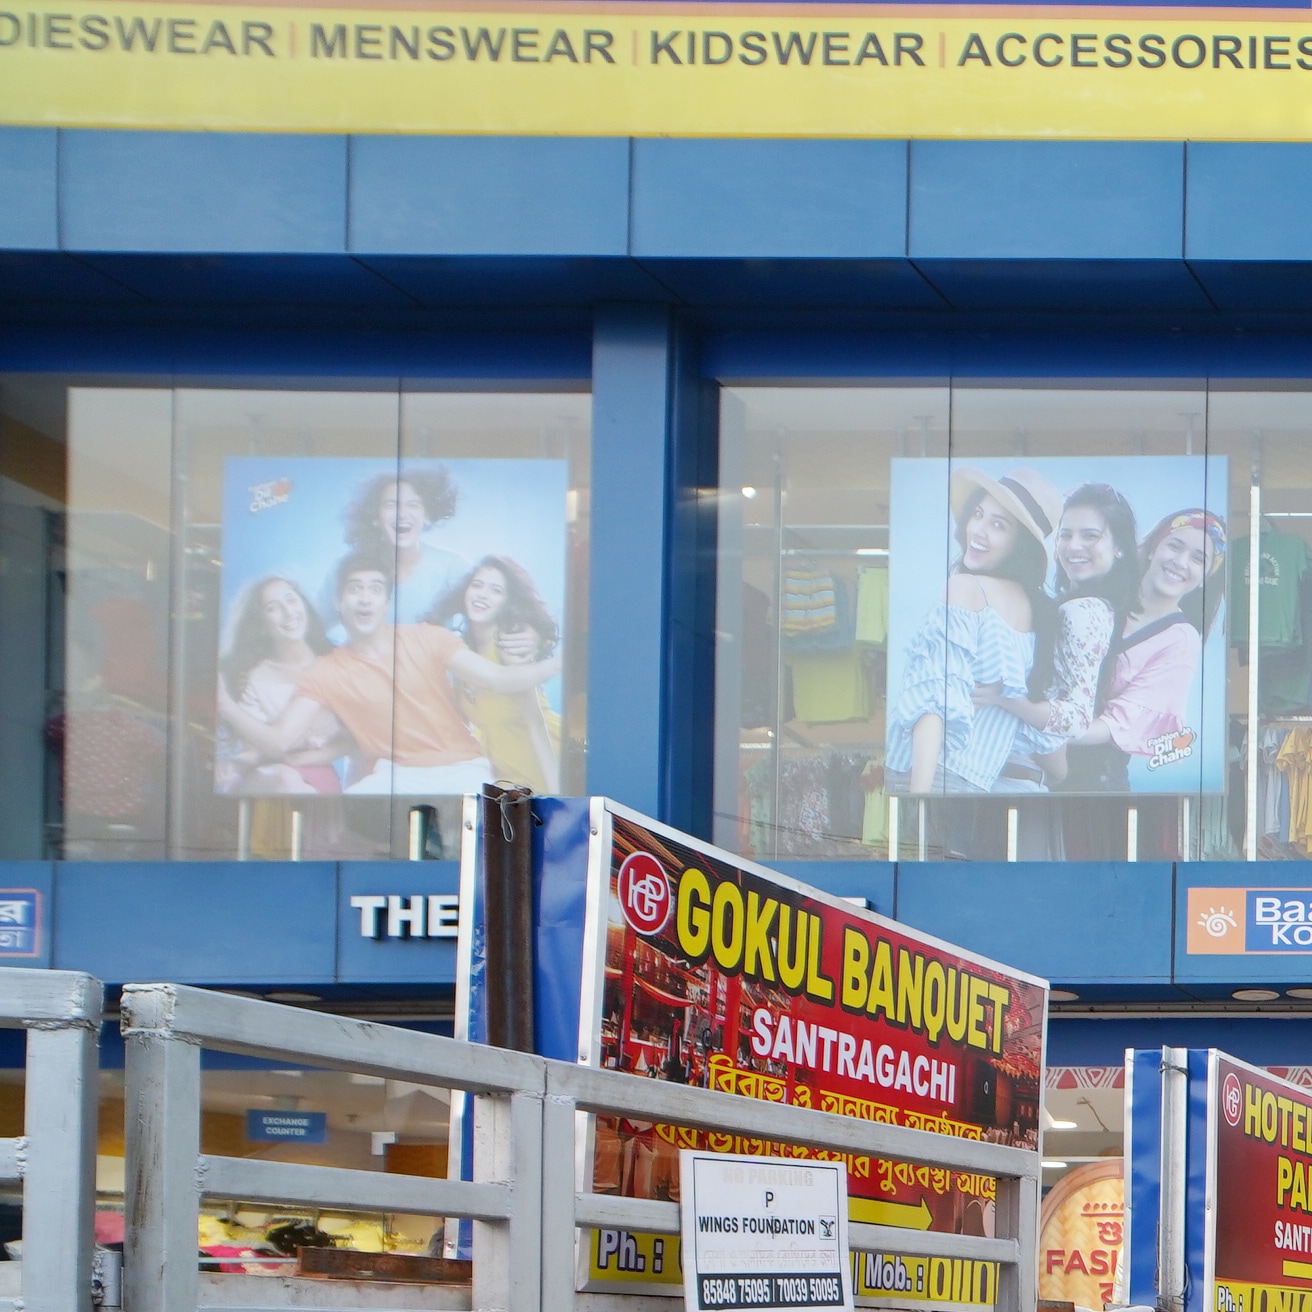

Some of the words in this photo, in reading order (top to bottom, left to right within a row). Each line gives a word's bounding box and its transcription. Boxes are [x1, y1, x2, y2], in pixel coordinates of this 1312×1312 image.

[308, 23, 616, 66] MENSWEAR
[648, 29, 926, 68] KIDSWEAR
[1149, 746, 1193, 769] Chahe
[1154, 739, 1173, 756] Dil
[350, 895, 459, 939] THE
[676, 867, 835, 1002] GOKUL
[842, 926, 1010, 1055] BANQUET
[751, 1007, 956, 1105] SANTRAGACHI
[262, 1116, 309, 1126] EXCHANGE
[265, 1126, 306, 1136] COUNTER
[699, 1216, 739, 1233] WINGS
[742, 1217, 815, 1235] FOUNDATION
[598, 1229, 646, 1273] Ph.
[865, 1252, 912, 1292] Mob.
[703, 1278, 737, 1304] 85848
[738, 1278, 770, 1303] 75095
[777, 1278, 808, 1302] 70039
[810, 1278, 839, 1301] 50095
